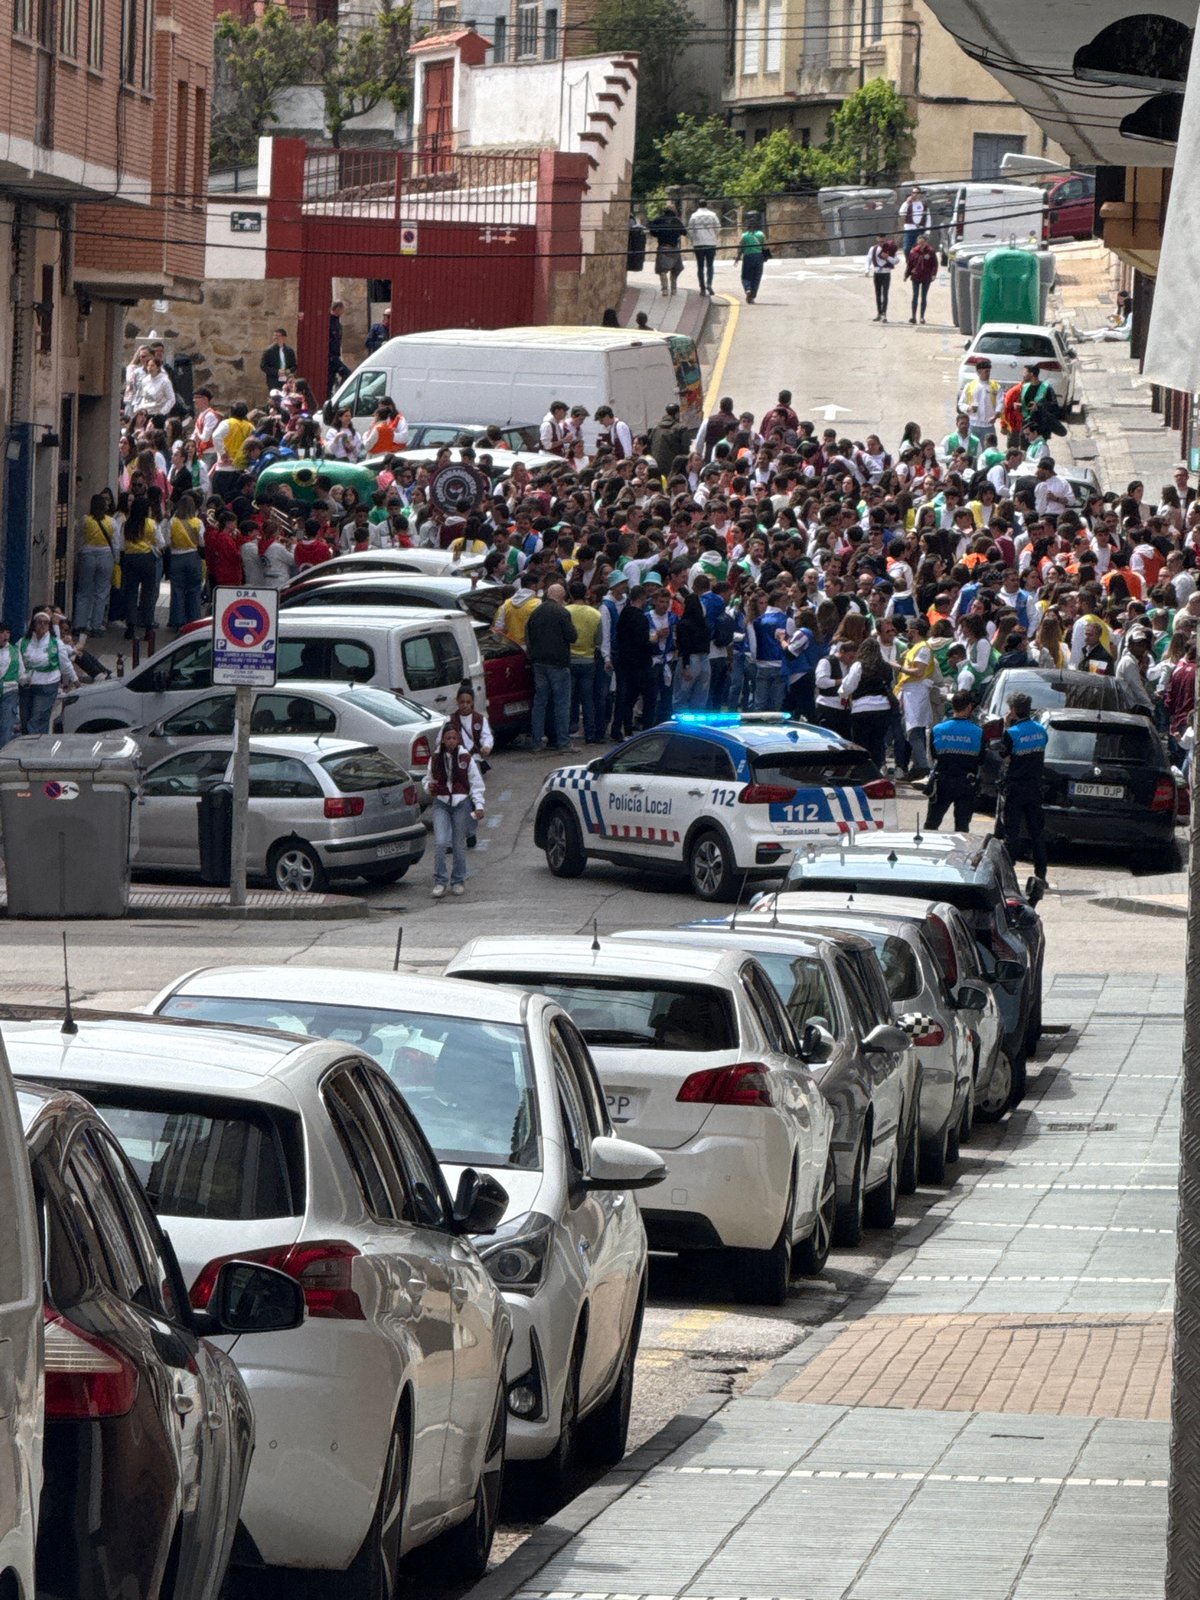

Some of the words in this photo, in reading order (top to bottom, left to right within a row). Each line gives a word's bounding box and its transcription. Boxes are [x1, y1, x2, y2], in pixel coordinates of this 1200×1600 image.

[711, 788, 736, 807] 112
[1103, 786, 1122, 797] DJP
[609, 793, 642, 813] Policía
[645, 796, 672, 815] Local
[782, 804, 819, 821] 112
